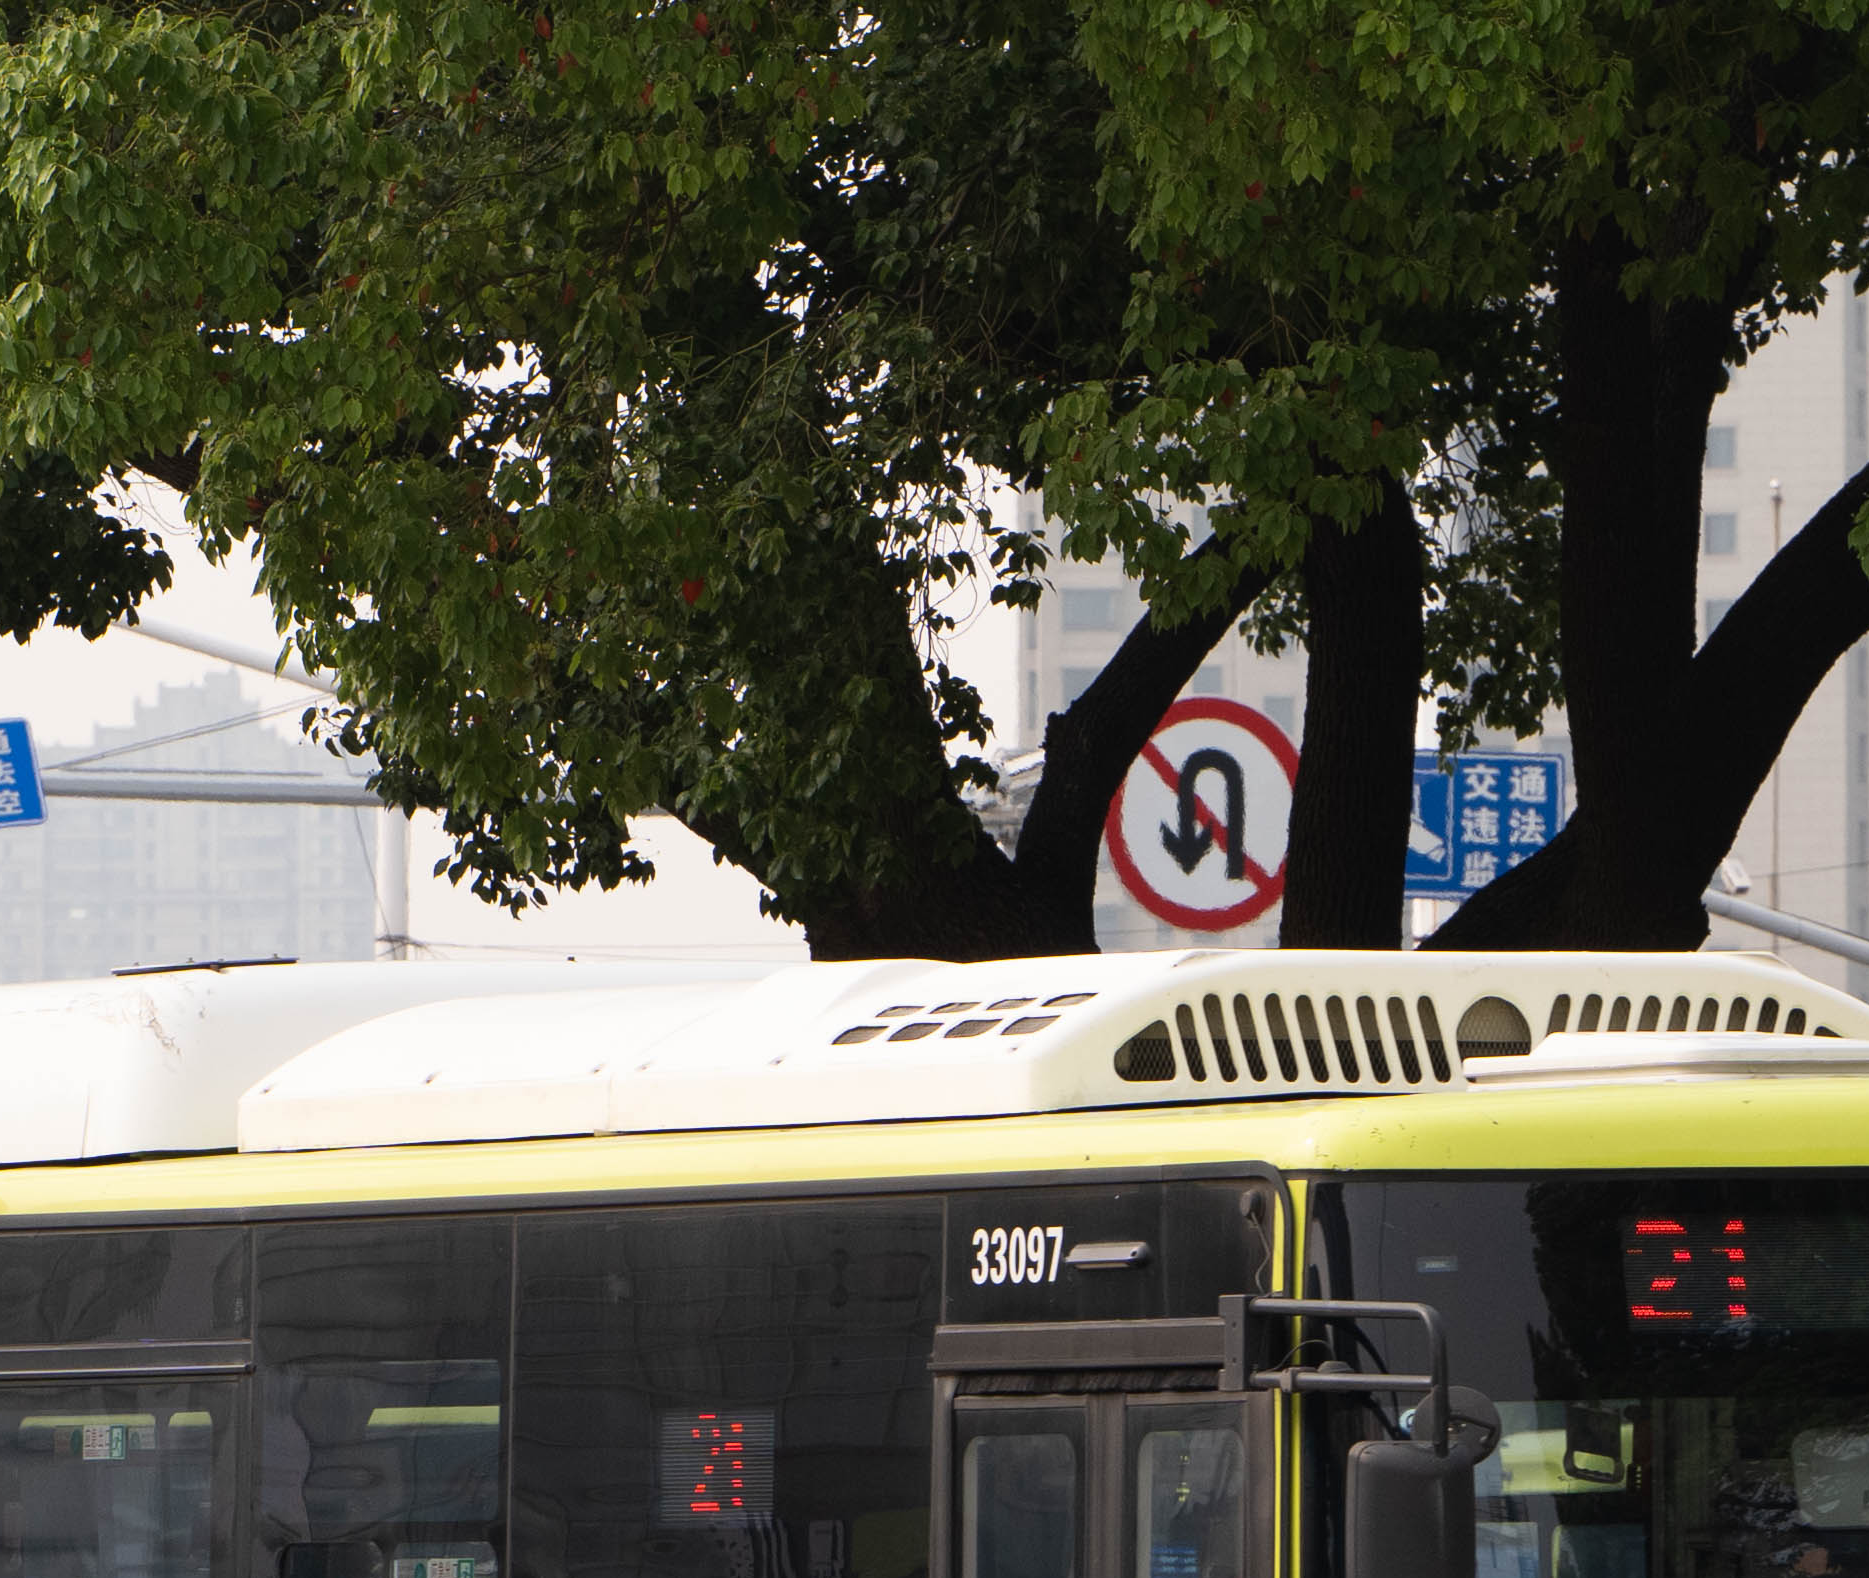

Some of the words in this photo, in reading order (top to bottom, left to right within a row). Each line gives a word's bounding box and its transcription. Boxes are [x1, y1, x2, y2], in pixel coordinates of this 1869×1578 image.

[1462, 764, 1547, 803] 交通
[1461, 807, 1546, 845] 违法
[1461, 851, 1530, 888] 监
[971, 1226, 1064, 1284] 33097
[1627, 1219, 1747, 1319] 21
[690, 1413, 744, 1512] 21
